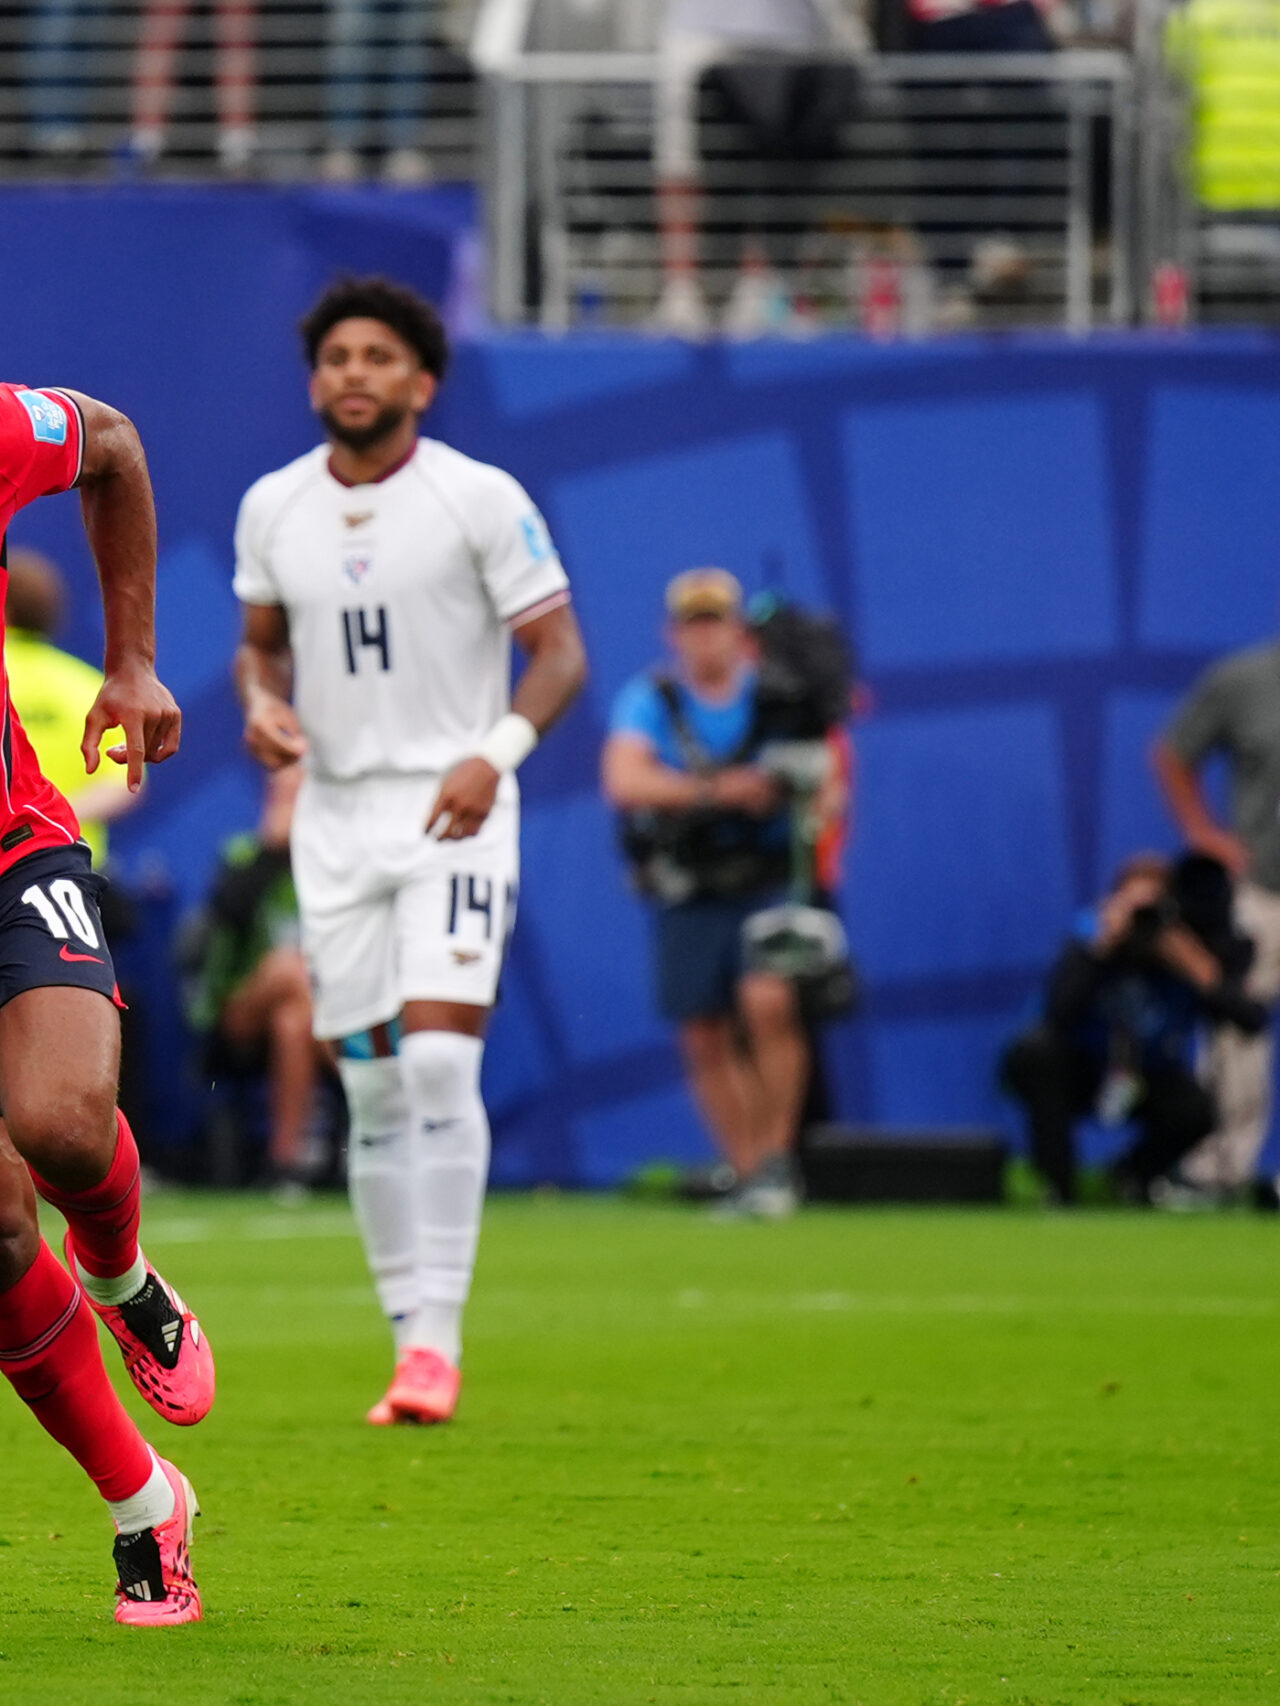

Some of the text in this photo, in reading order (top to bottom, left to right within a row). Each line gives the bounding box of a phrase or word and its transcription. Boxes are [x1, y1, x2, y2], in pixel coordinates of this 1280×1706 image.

[342, 605, 390, 675] 14
[21, 879, 99, 949] 10
[449, 874, 492, 939] 14
